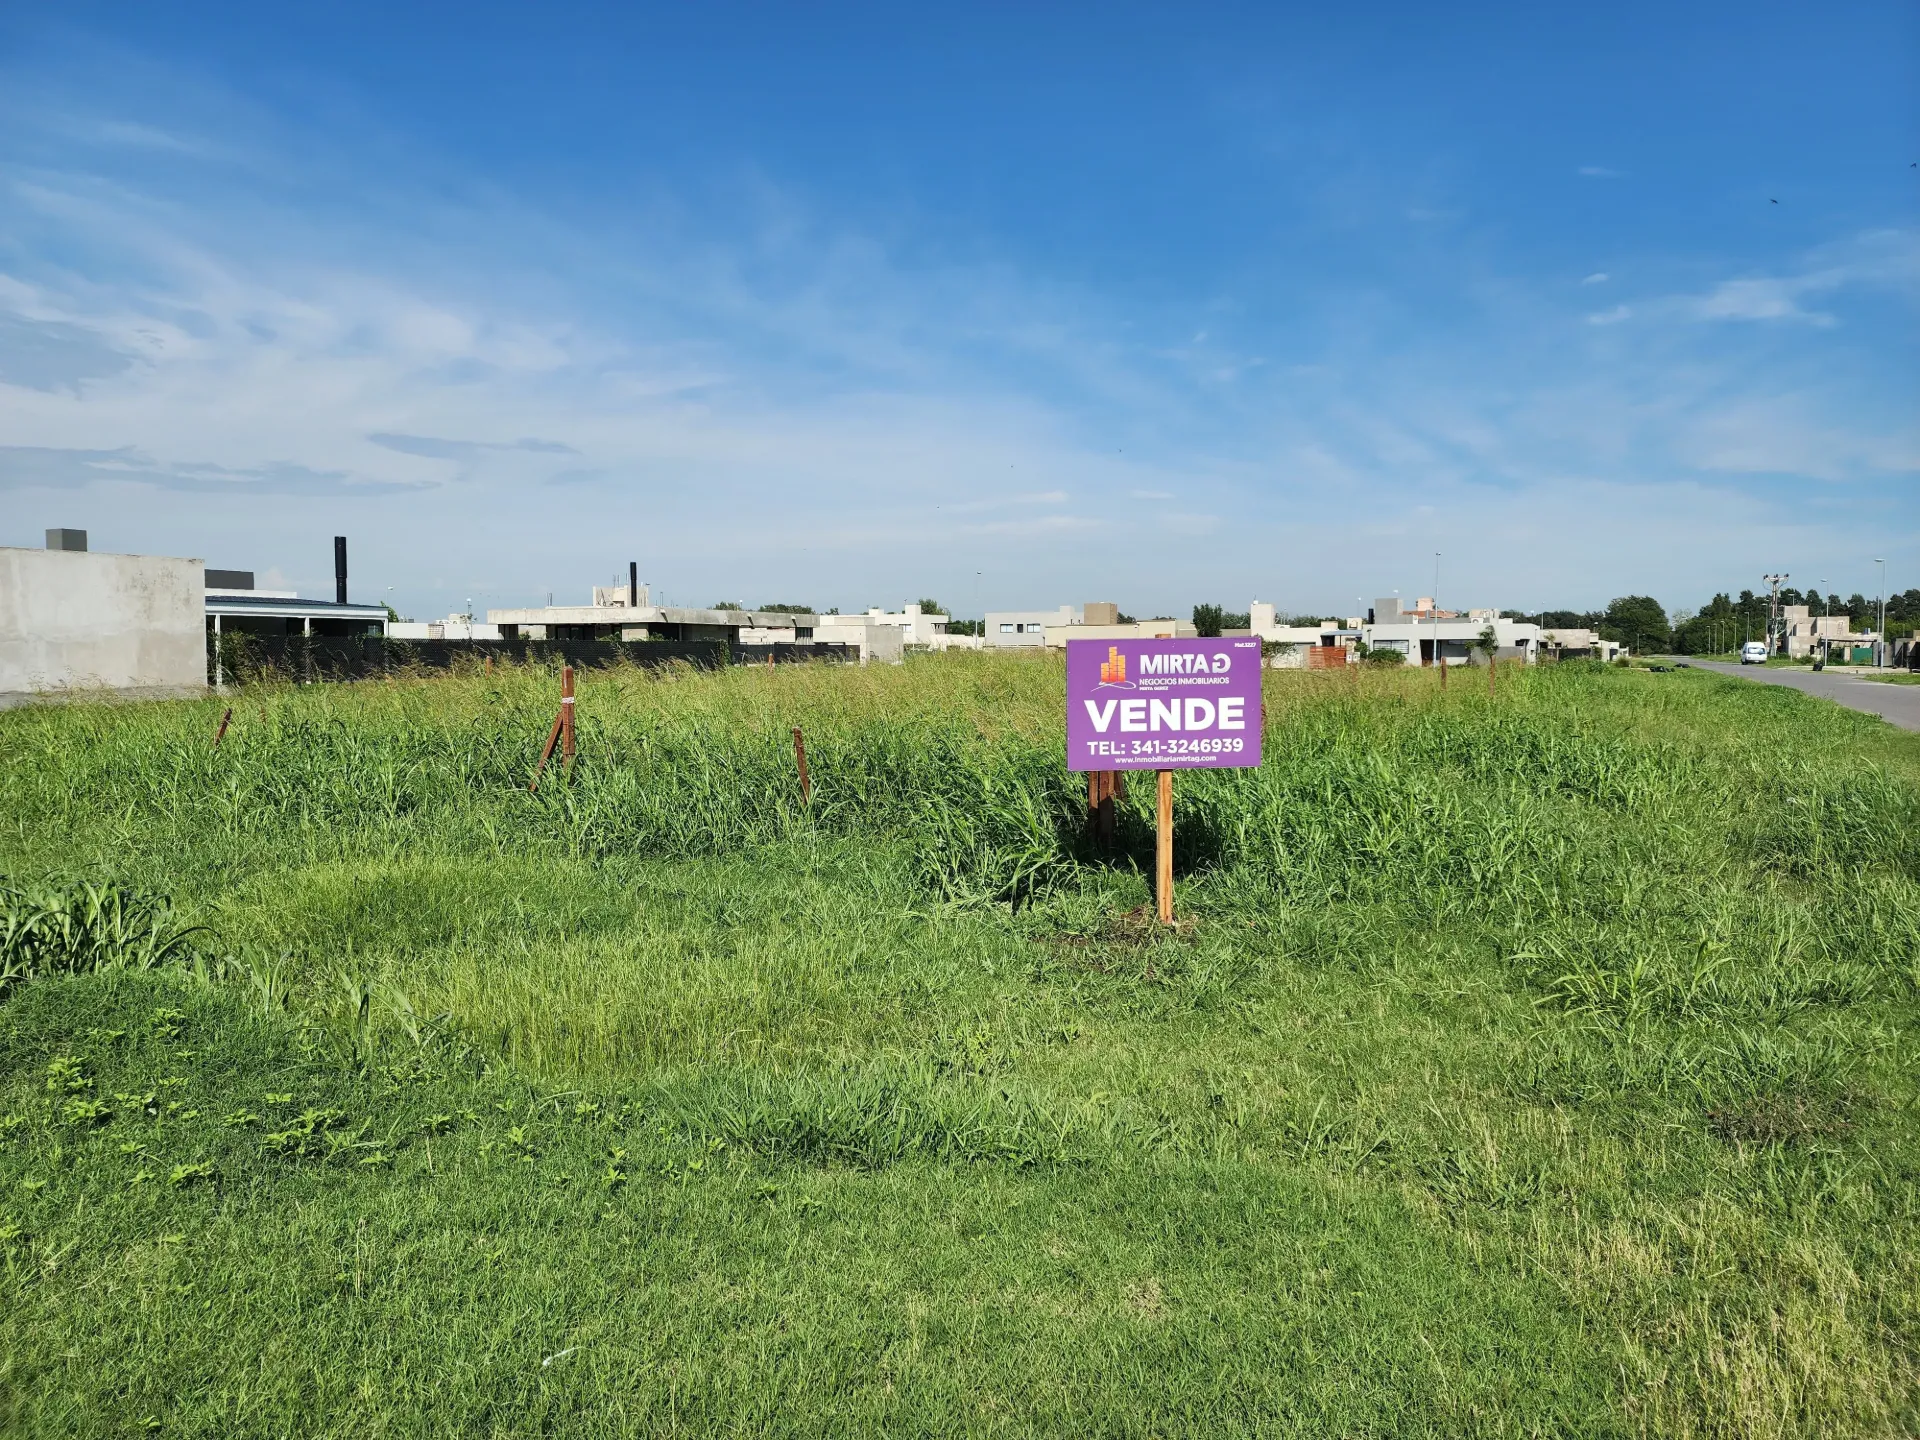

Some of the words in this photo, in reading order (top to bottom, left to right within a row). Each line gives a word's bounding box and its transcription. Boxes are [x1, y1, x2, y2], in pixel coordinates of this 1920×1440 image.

[1139, 678, 1177, 686] NEGOCIOS
[1178, 677, 1230, 685] INMOBILIARIOS
[1084, 697, 1245, 733] VENDE
[1087, 741, 1126, 755] TEL:
[1131, 738, 1244, 754] 341-3246939
